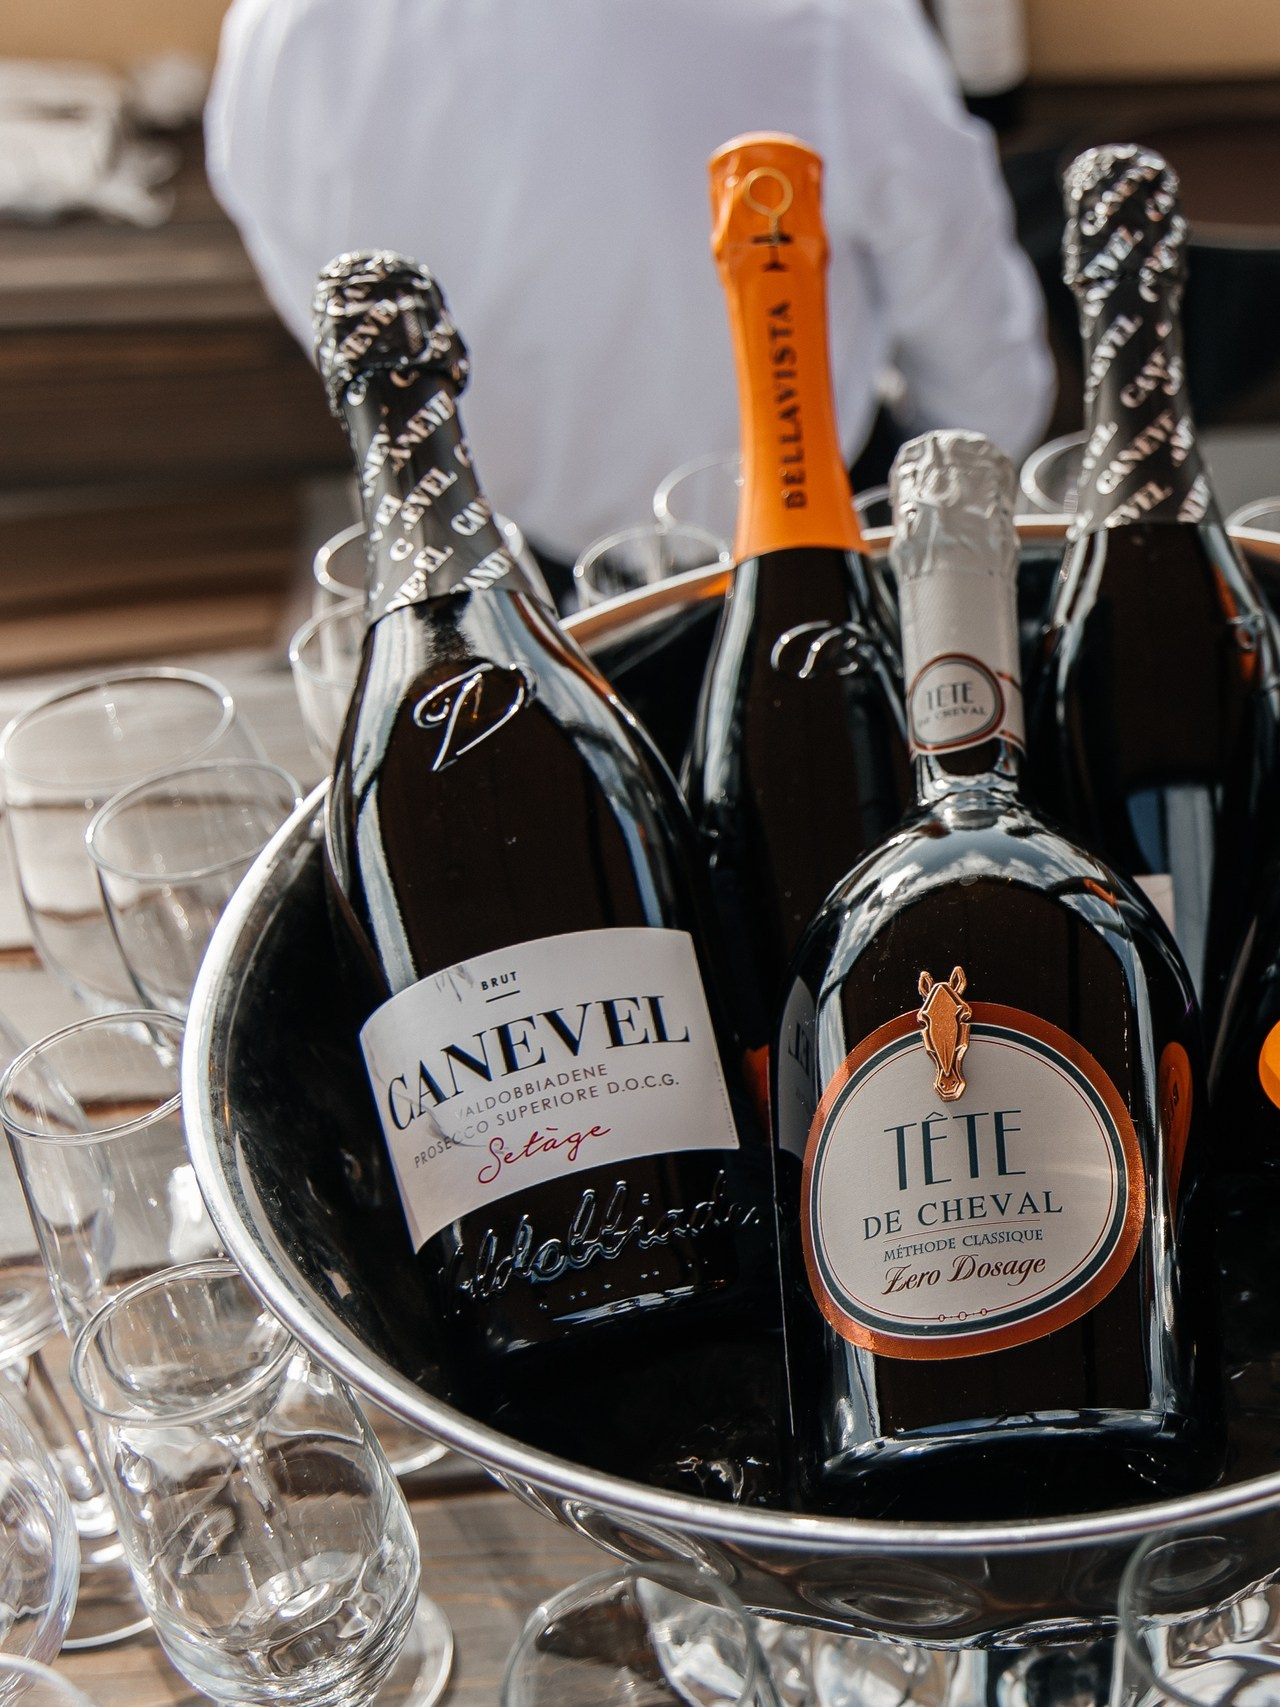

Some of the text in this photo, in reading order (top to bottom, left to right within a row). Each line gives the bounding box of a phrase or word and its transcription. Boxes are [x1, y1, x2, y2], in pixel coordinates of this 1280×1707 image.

[766, 299, 807, 511] BELLAVISTA
[481, 970, 518, 992] BRUT
[387, 995, 690, 1131] CANEVEL
[455, 1063, 608, 1119] VALDOBBIADENE
[414, 1072, 680, 1168] PROSECCO SUPERIORE D.O.C.G.
[477, 1124, 612, 1186] Setàge
[883, 1109, 1026, 1192] TÊTE
[863, 1191, 1063, 1240] DE CHEVAL
[881, 1253, 1047, 1296] Zero Dosage
[883, 1229, 1044, 1262] MÉTHODE CLASSIQUE
